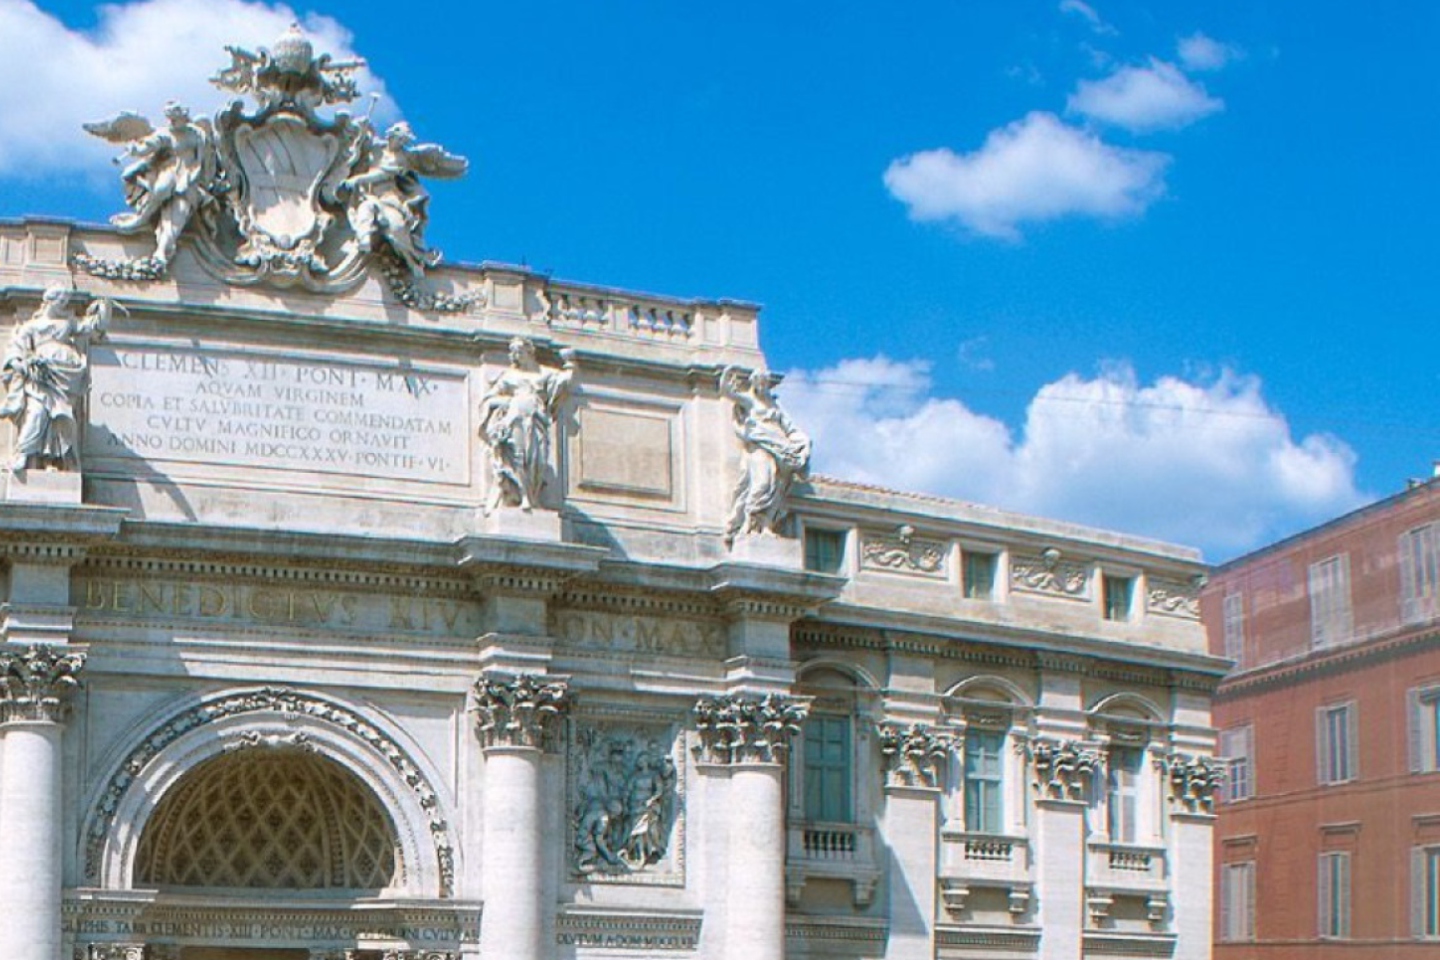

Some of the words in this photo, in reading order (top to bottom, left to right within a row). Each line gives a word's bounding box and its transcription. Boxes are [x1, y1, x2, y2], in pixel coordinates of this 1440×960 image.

[195, 381, 261, 400] AQVAM
[274, 386, 365, 408] VIRGINEM
[100, 391, 154, 410] COPIA
[163, 396, 181, 412] ET
[190, 398, 306, 421] SALVBRITATE
[314, 408, 452, 436] COMMENDATAM
[107, 432, 163, 448] ANNO
[169, 435, 236, 454] DOMINI
[147, 415, 207, 432] CVLTV
[218, 420, 321, 442] MAGNIFICO
[329, 428, 410, 450] ORNAVIT
[85, 579, 357, 624] BENEDICTVS
